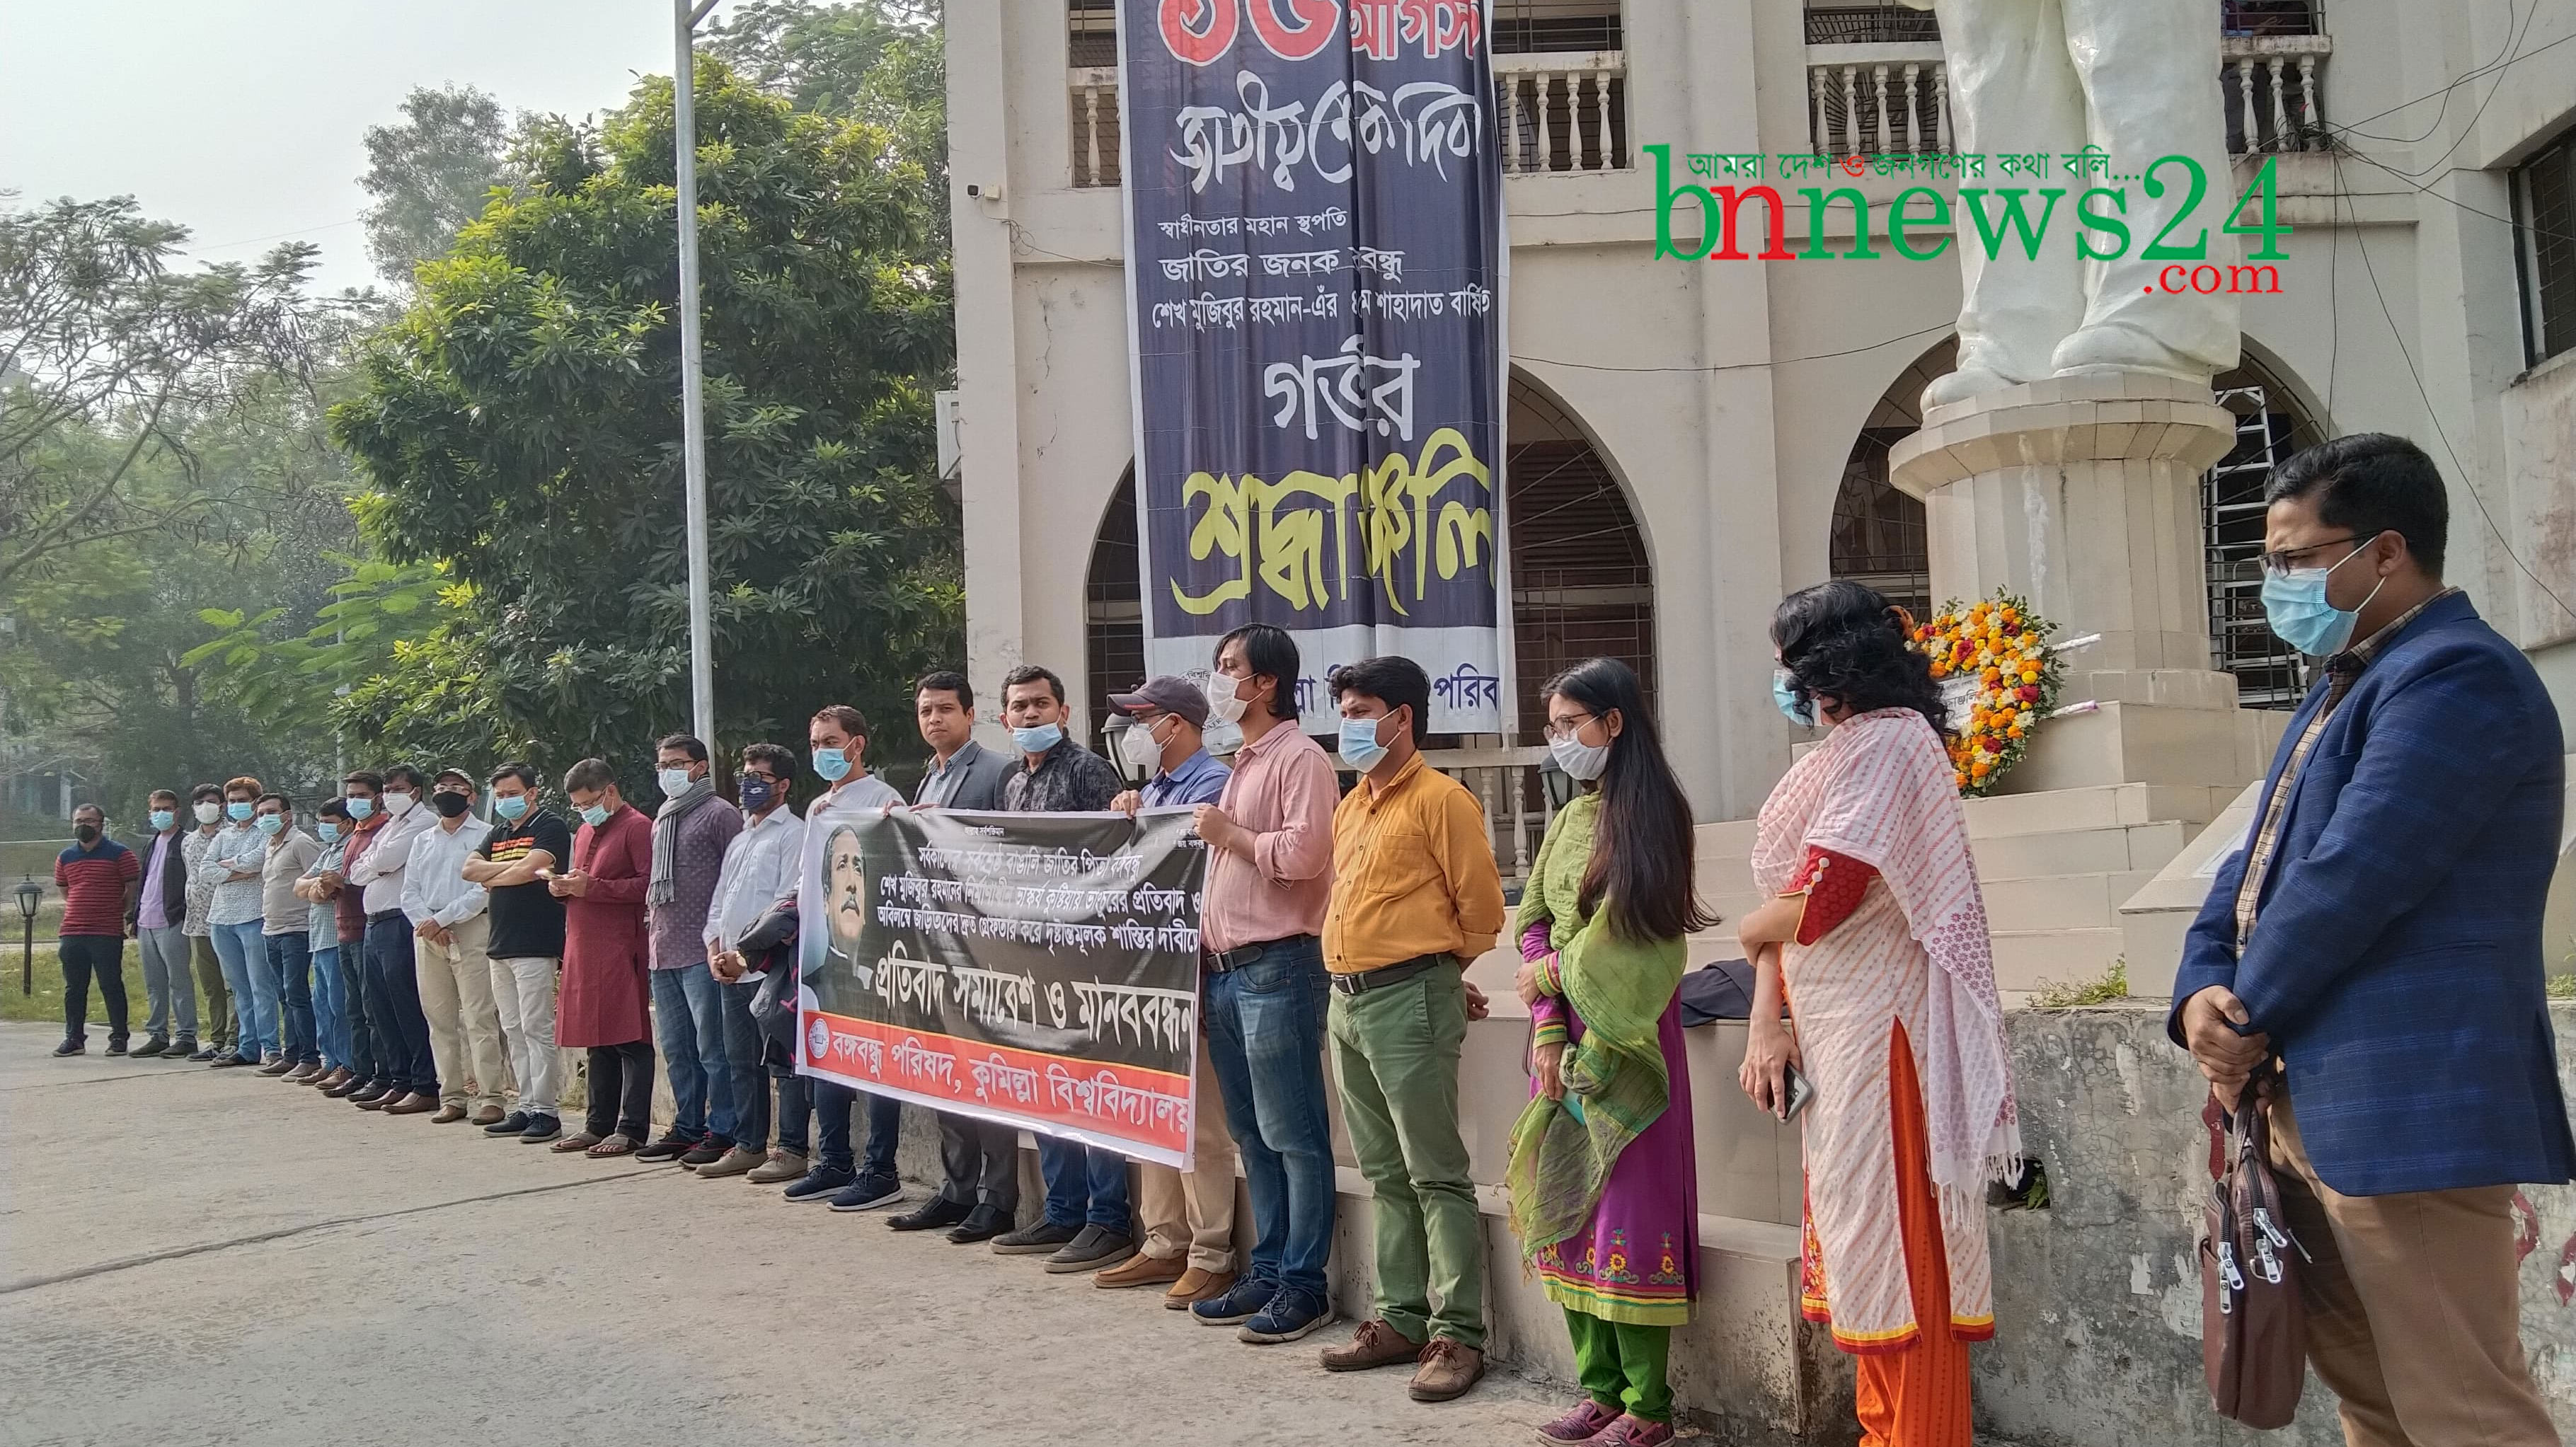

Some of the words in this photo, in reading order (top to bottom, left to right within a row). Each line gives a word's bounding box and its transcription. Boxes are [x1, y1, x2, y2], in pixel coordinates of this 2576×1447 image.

[1157, 213, 1239, 241] স্বাধীনতার
[1243, 214, 1290, 238] মহান
[1294, 207, 1348, 238] স্থপতি
[1158, 248, 1251, 282] জাতির
[1258, 249, 1341, 278] জনক
[1152, 297, 1187, 328] শেখ
[1189, 291, 1246, 334] মুজিবুর
[1375, 289, 1445, 323] শাহাদাত
[1043, 846, 1078, 878] জাতির
[1081, 848, 1111, 879] পিতা
[880, 874, 898, 897] শেখ
[899, 870, 929, 904] মুজিবুর
[930, 879, 963, 904] রহমানের
[1132, 882, 1186, 916] প্রতিবাদ
[1191, 892, 1202, 913] ও
[1020, 921, 1043, 945] করে
[1109, 918, 1155, 951] শাস্তির
[875, 939, 948, 1017] প্রতিবাদ
[951, 963, 1036, 1032] সমাবেশ
[1044, 981, 1067, 1030] ও
[1069, 974, 1195, 1056] মানববন্ধন
[832, 1031, 886, 1080] বঙ্গবন্ধু
[891, 1036, 962, 1094] পরিষদ,
[967, 1052, 1039, 1104] কুমিল্লা
[1044, 1063, 1190, 1134] বিশ্ববিদ্যালয়
